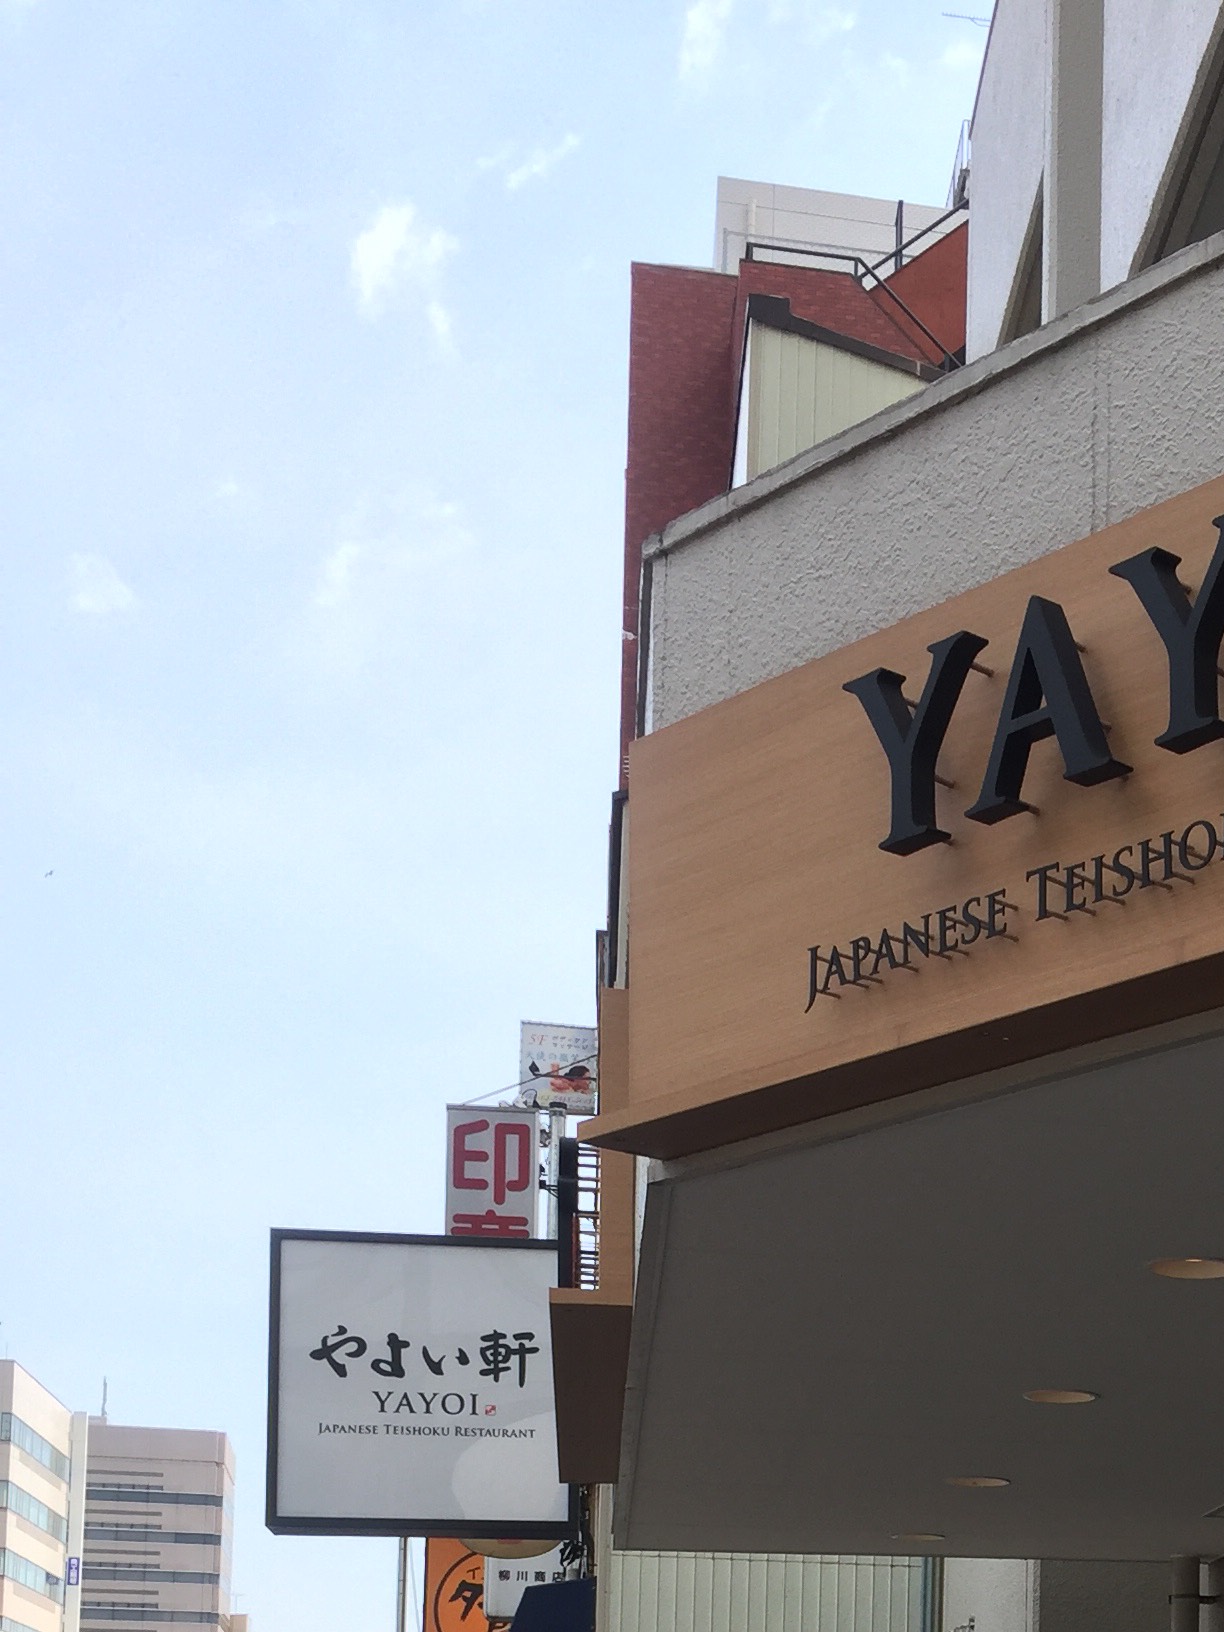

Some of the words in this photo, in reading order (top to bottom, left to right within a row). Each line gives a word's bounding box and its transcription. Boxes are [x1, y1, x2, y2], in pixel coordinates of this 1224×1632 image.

[804, 888, 1007, 1014] JAPANESE
[308, 1324, 541, 1389] やよい軒
[371, 1390, 480, 1416] YAYOI
[317, 1422, 379, 1436] JAPANESE
[383, 1424, 451, 1437] TEISHOKU
[454, 1425, 537, 1439] RESTAURANT
[498, 1570, 565, 1584] 柳川商店
